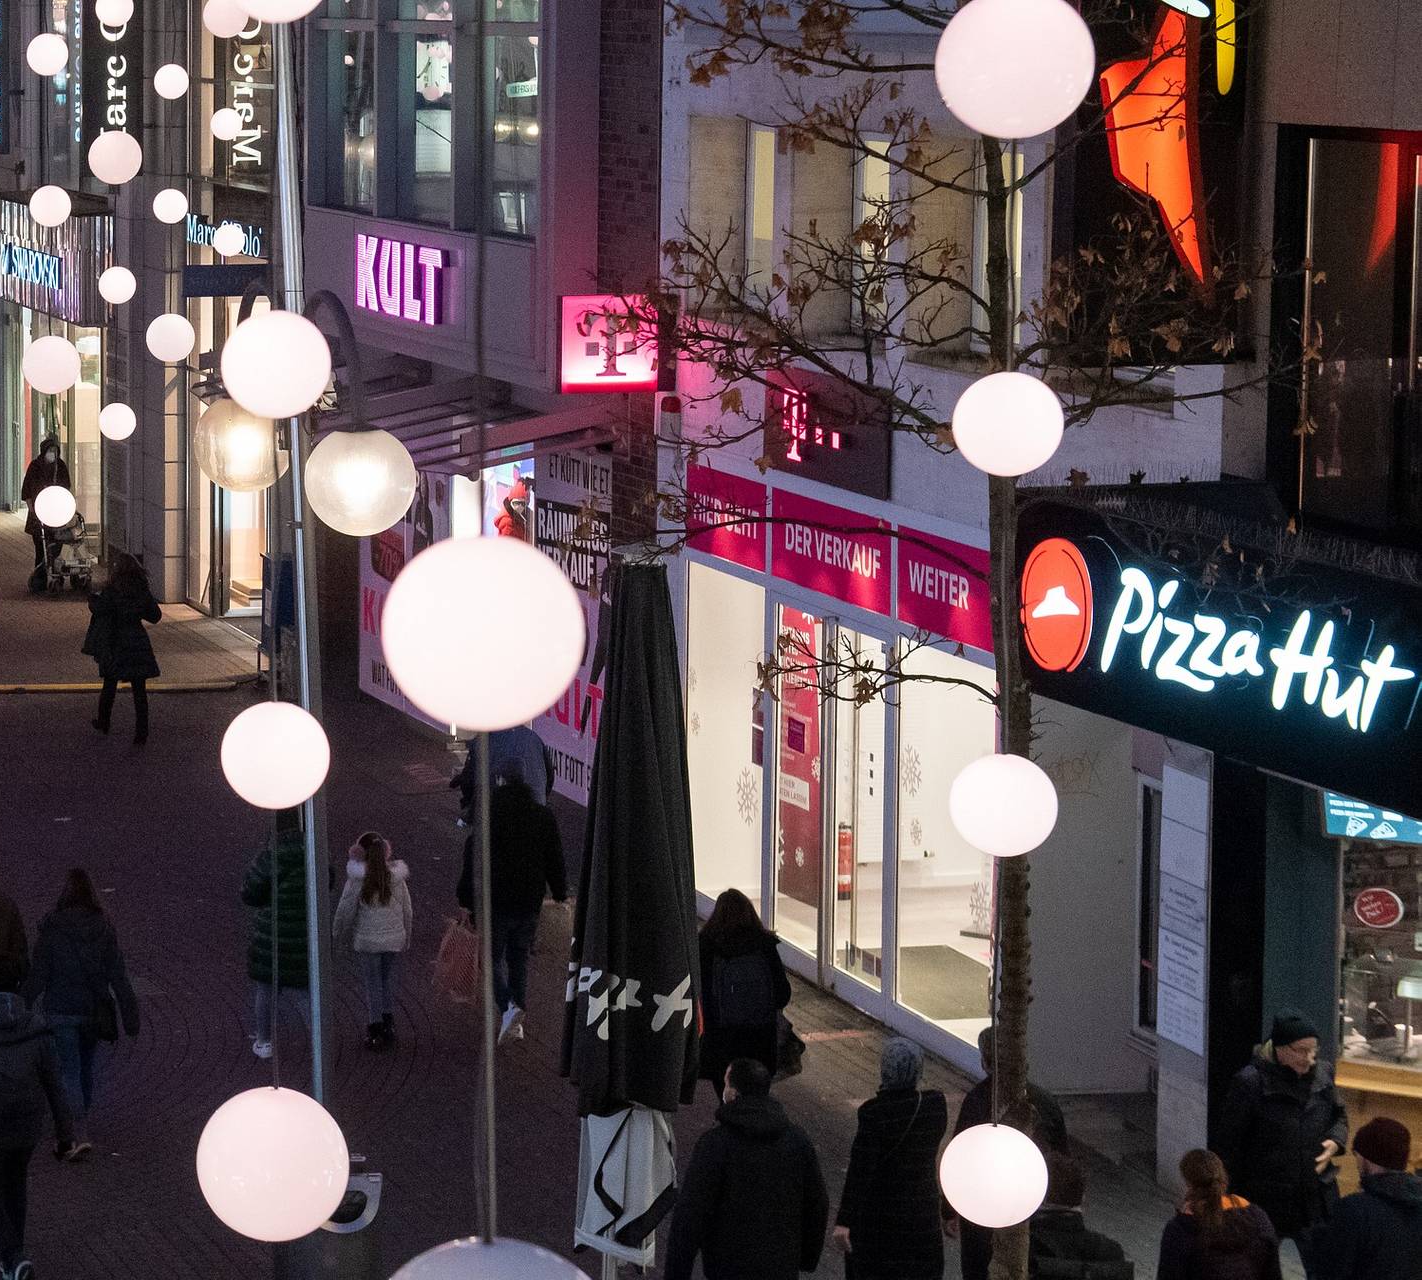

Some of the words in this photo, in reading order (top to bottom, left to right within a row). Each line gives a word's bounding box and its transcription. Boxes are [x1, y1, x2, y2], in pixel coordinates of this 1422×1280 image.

[12, 245, 59, 291] SWAROVSKI
[357, 233, 443, 326] KULT
[785, 523, 812, 559] DER
[814, 530, 881, 579] VERKAUF
[908, 560, 970, 611] WEITER
[1100, 567, 1264, 693] Pizza
[1270, 609, 1416, 734] Hut
